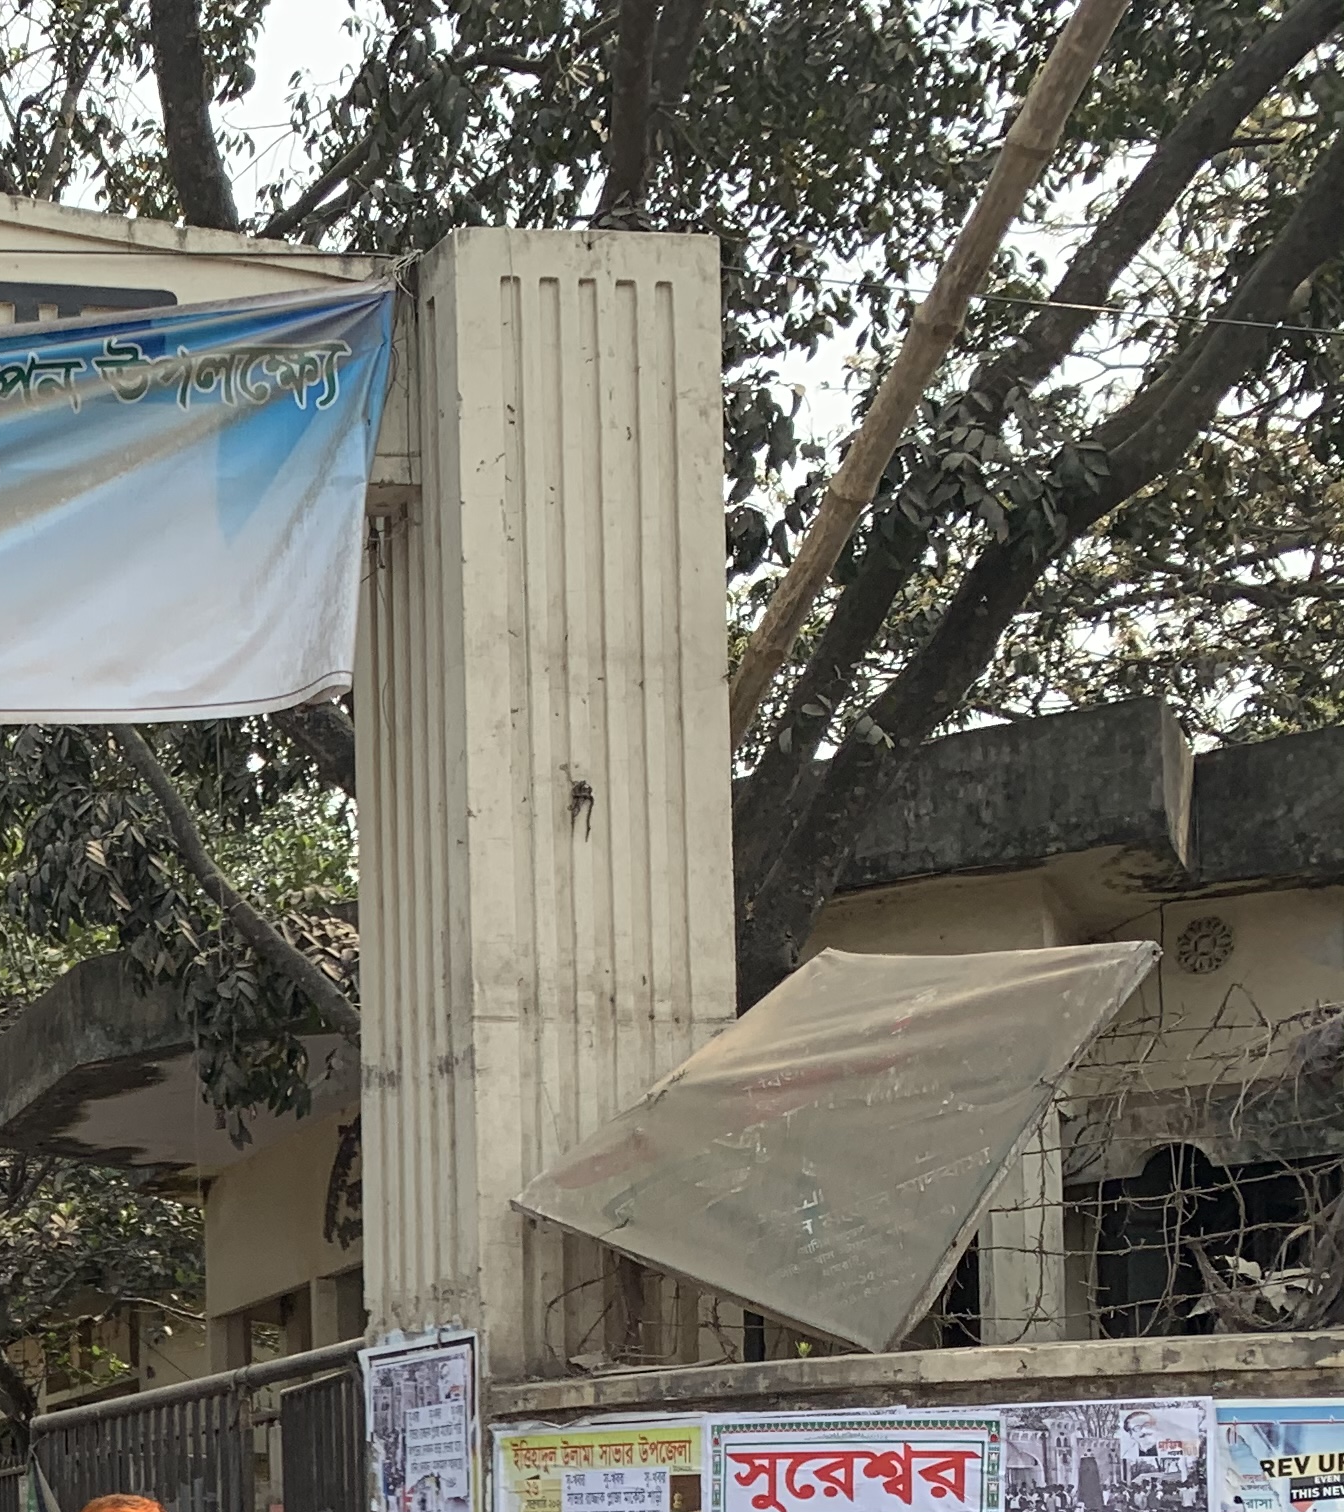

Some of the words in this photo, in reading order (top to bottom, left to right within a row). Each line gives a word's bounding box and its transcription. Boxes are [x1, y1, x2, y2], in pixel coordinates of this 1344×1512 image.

[598, 1441, 635, 1465] সাভার
[638, 1434, 693, 1464] উপজেলা
[1260, 1455, 1311, 1478] REV
[1314, 1475, 1341, 1484] EVEN
[1291, 1488, 1320, 1500] THIS
